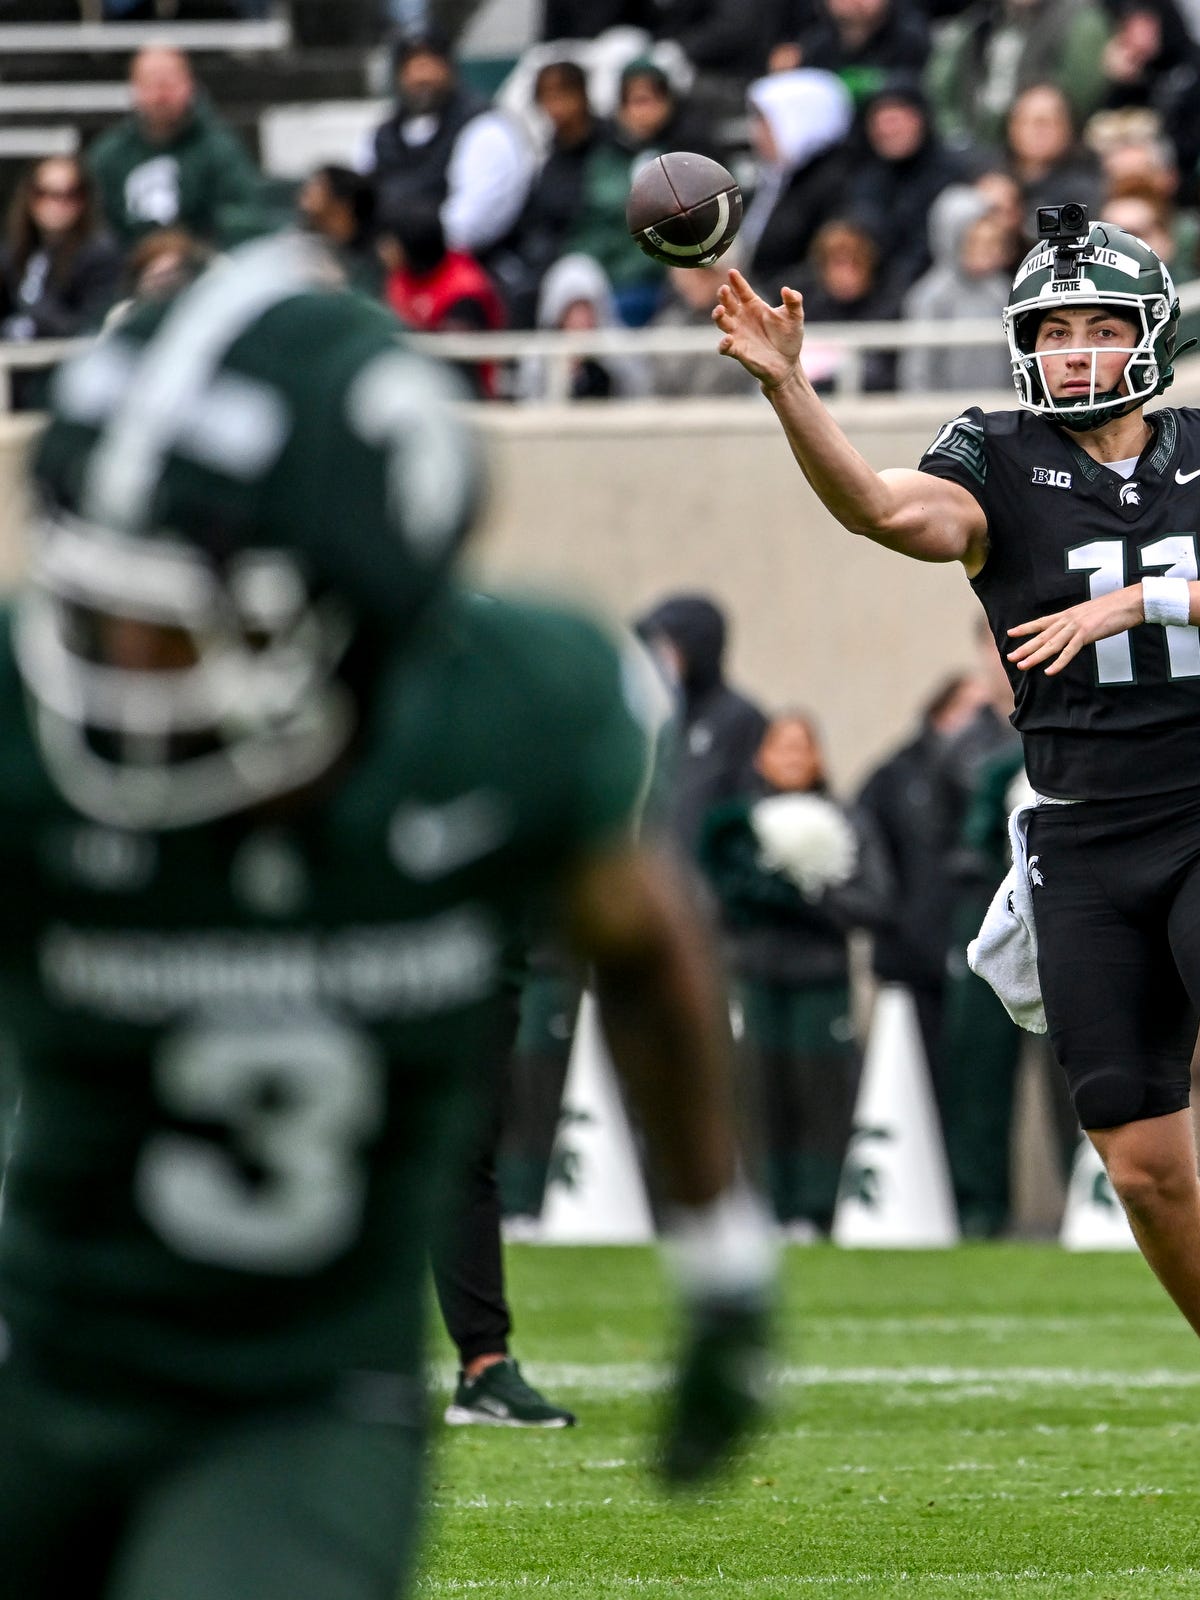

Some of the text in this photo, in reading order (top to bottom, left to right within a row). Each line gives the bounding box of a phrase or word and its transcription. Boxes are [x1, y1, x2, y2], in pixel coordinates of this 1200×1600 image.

[1026, 249, 1117, 274] MILIVIC
[1051, 280, 1081, 293] STATE
[132, 1018, 386, 1276] 3
